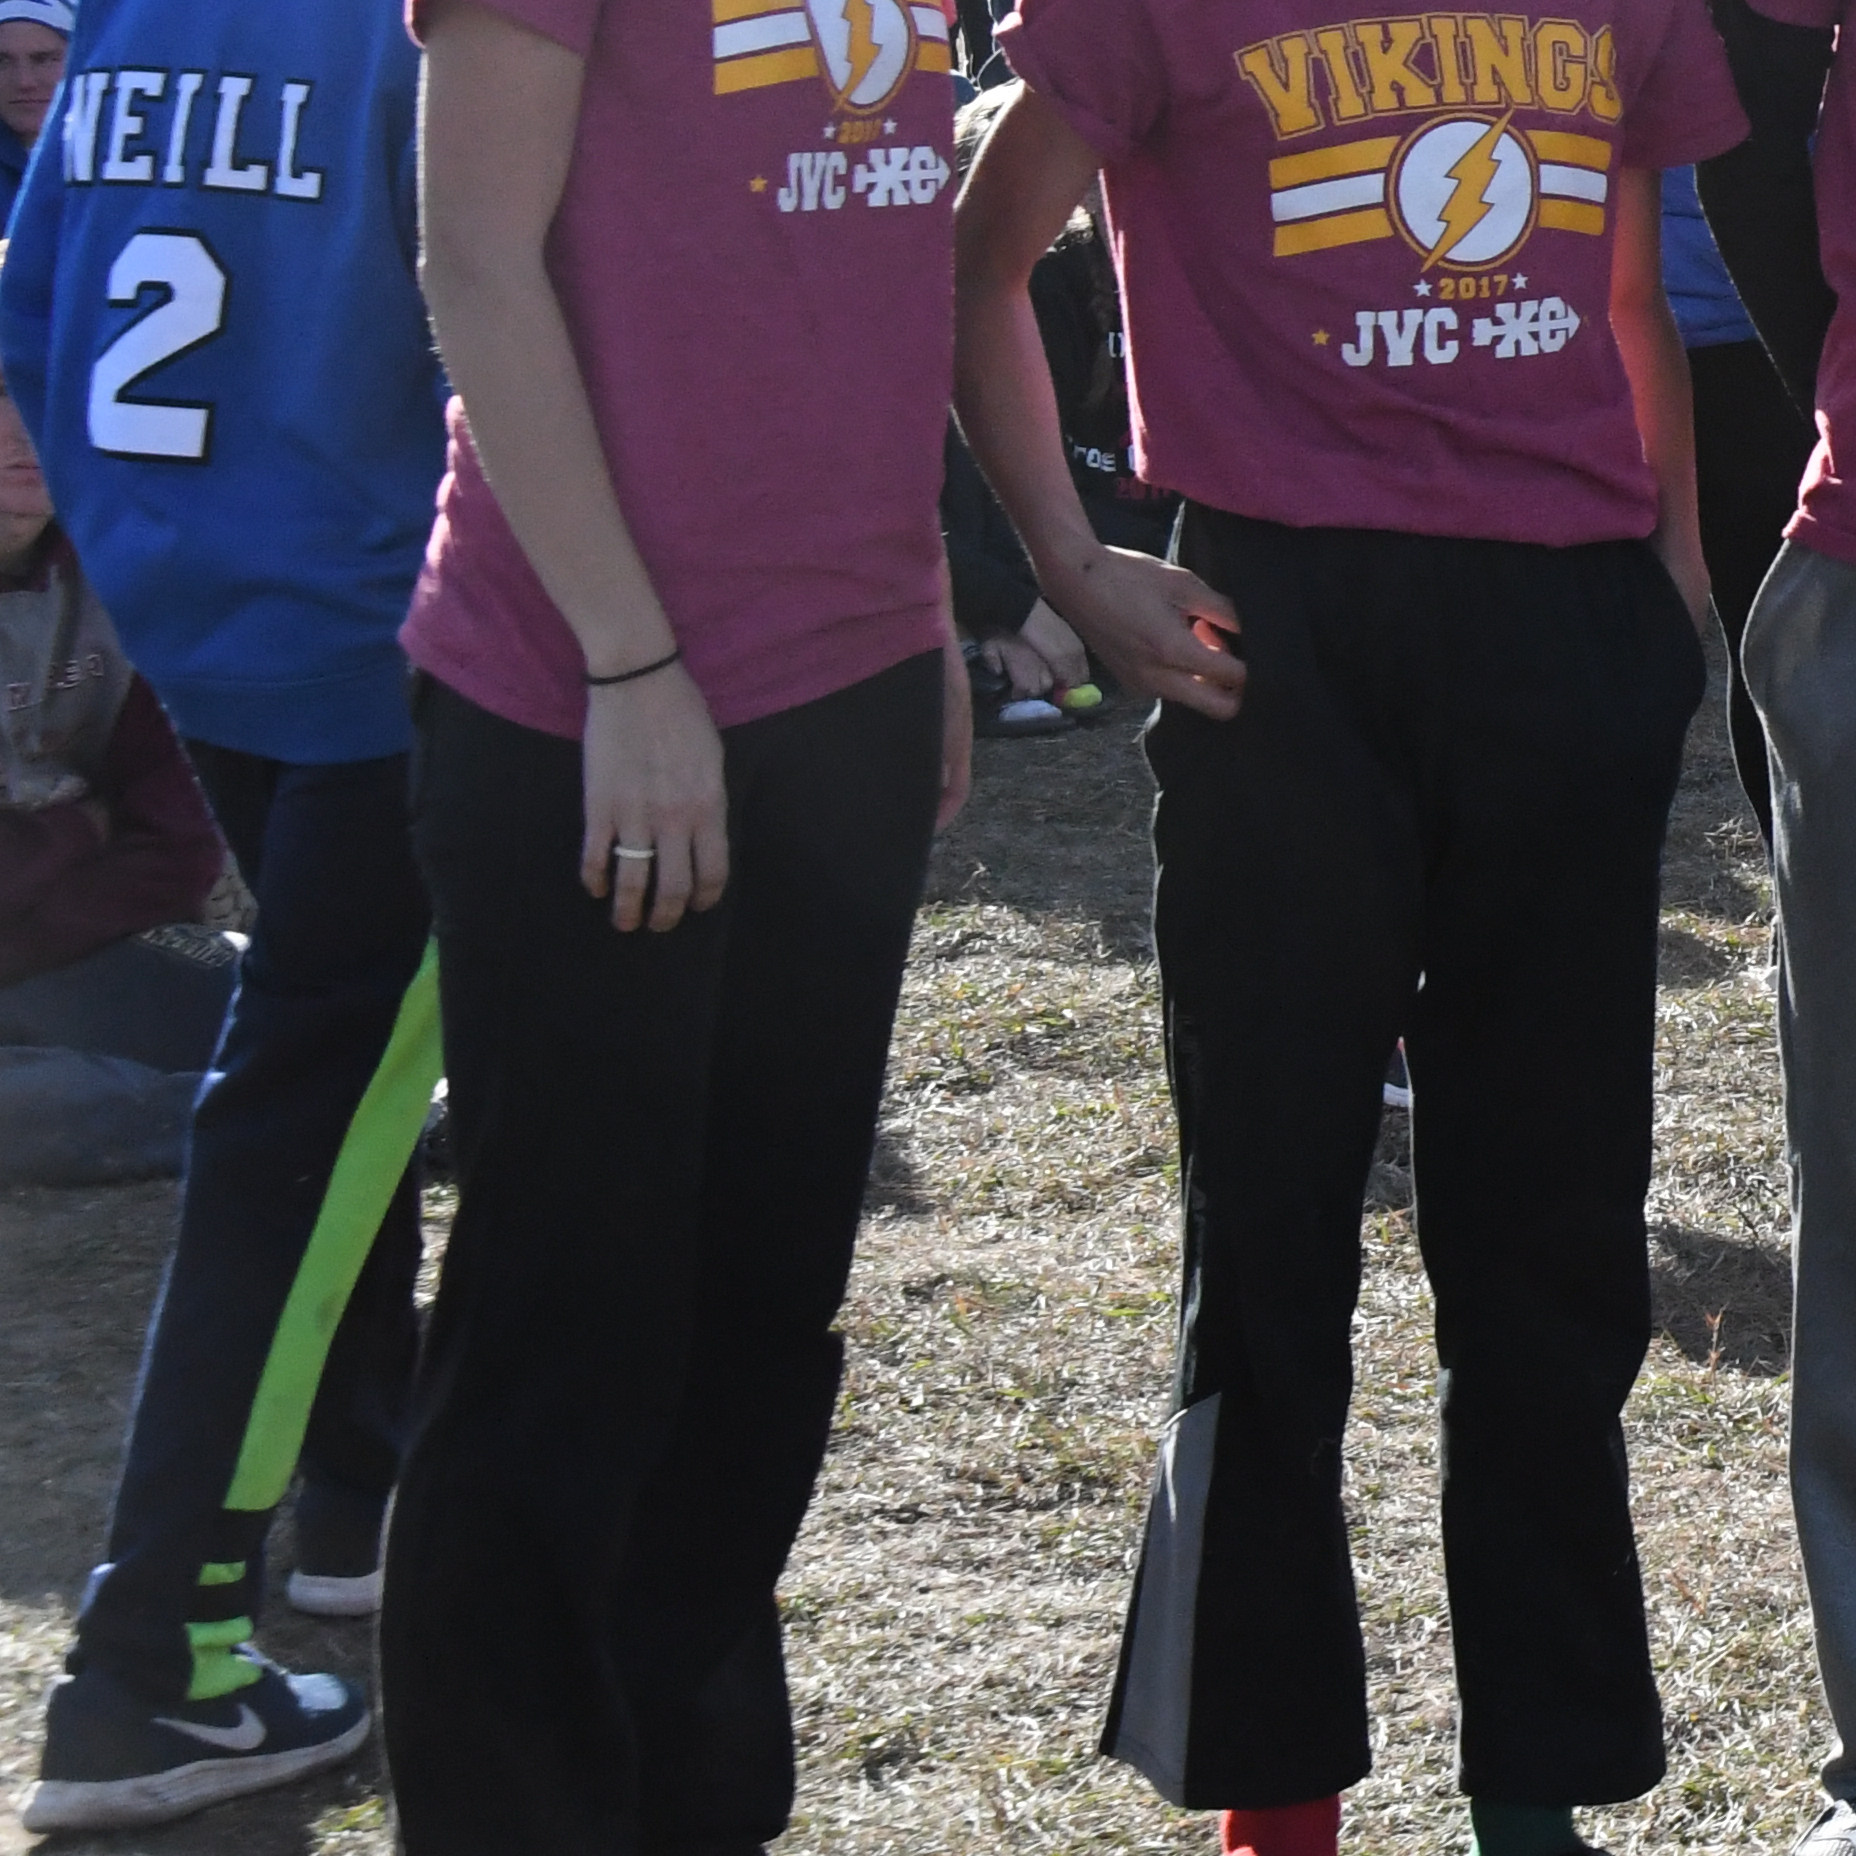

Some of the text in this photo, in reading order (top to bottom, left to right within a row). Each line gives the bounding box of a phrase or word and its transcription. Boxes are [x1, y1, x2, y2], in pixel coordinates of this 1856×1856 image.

[777, 152, 847, 212] JVC
[1438, 274, 1509, 300] 2017
[87, 226, 236, 466] 2
[1340, 307, 1459, 367] JVC
